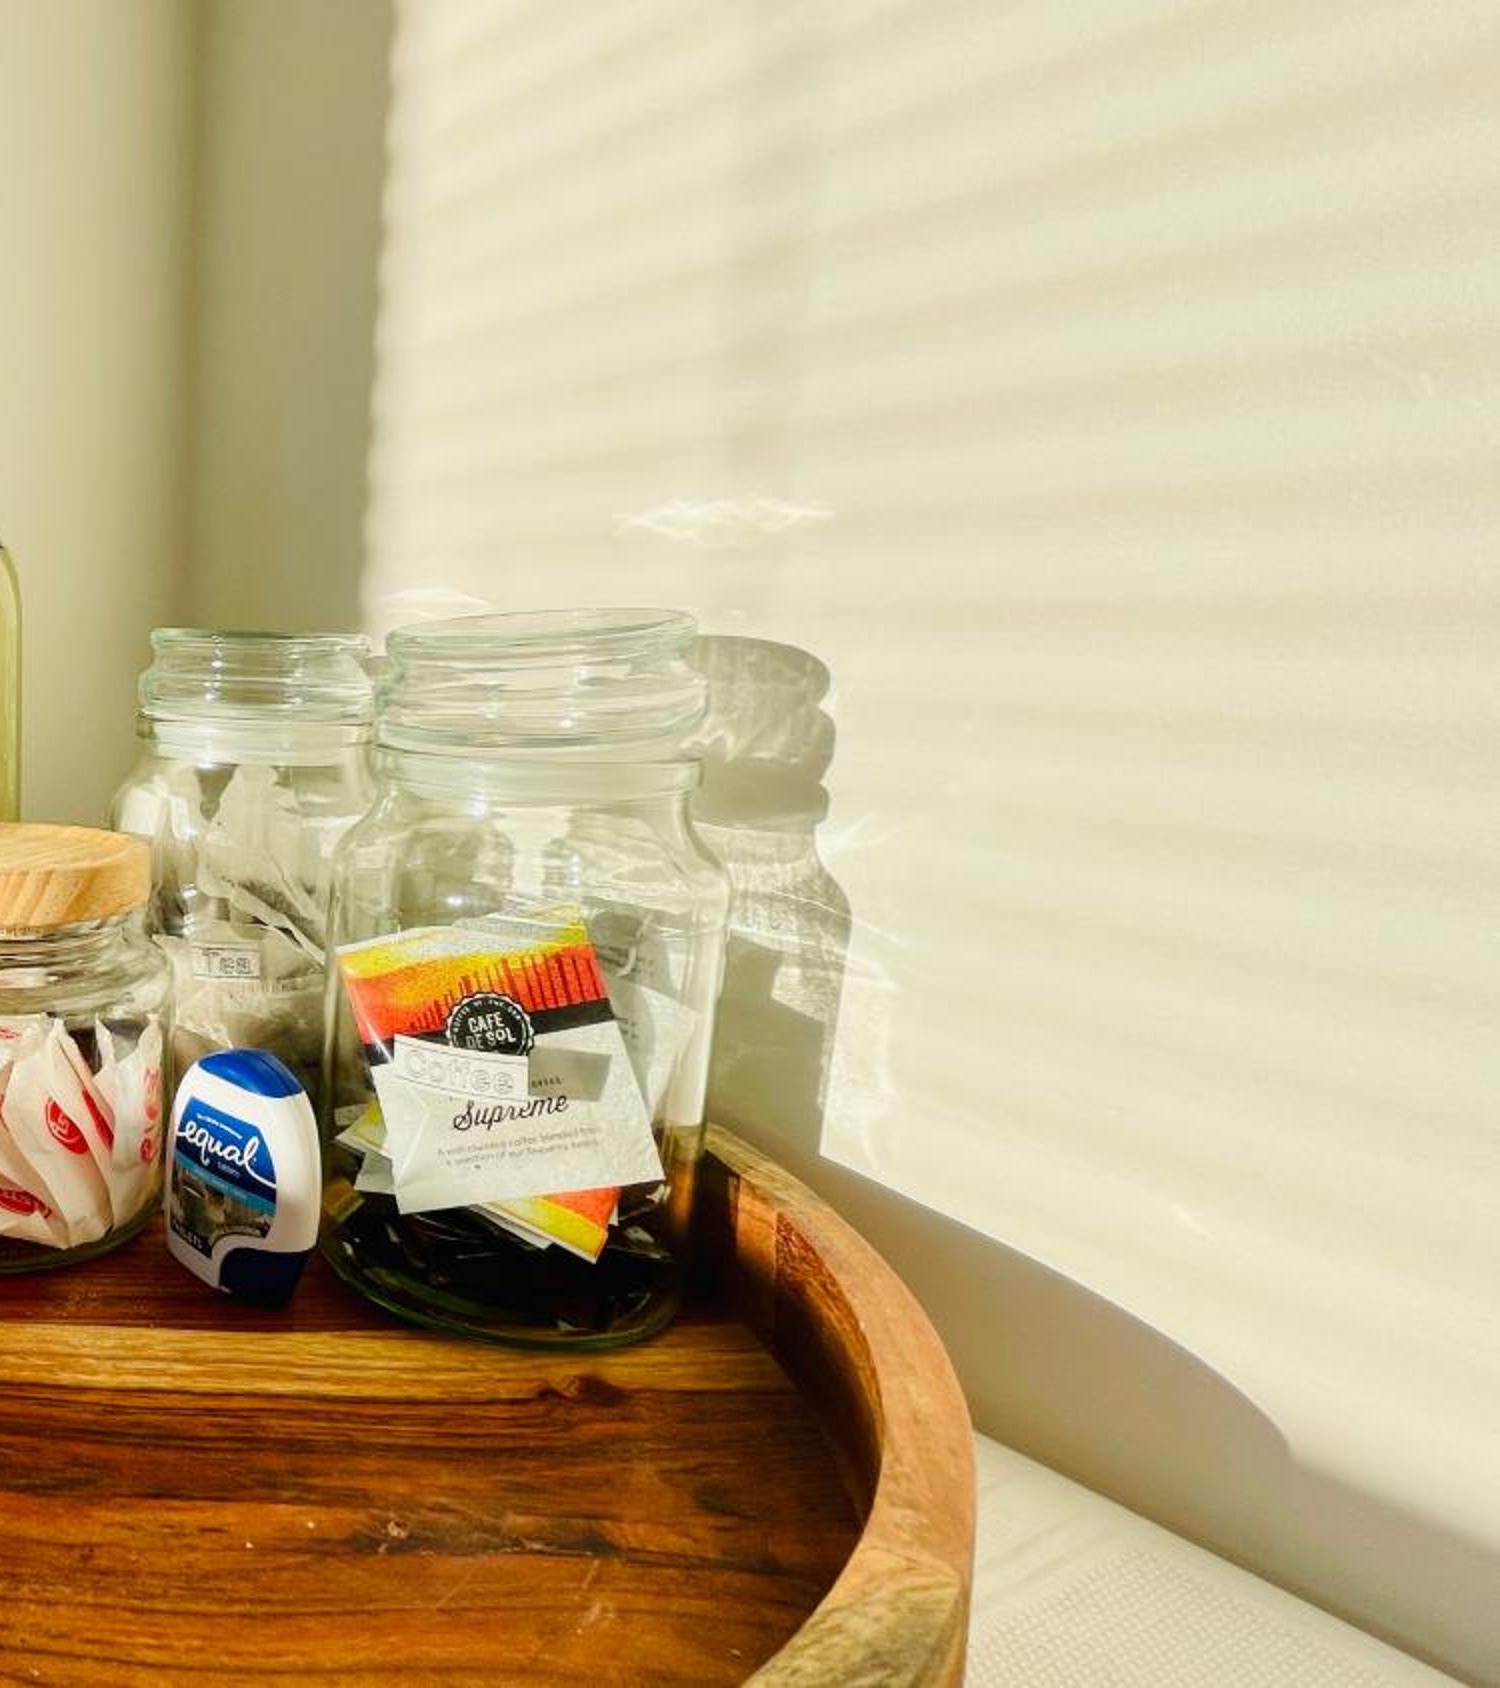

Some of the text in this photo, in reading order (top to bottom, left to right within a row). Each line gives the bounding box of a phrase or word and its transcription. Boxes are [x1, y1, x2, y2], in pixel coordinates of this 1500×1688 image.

[202, 949, 254, 975] Tea
[467, 1011, 506, 1033] CAFE
[465, 1027, 517, 1049] DE SOL
[406, 1050, 515, 1094] Coffee
[453, 1095, 569, 1131] Supreme
[177, 1121, 270, 1182] equal
